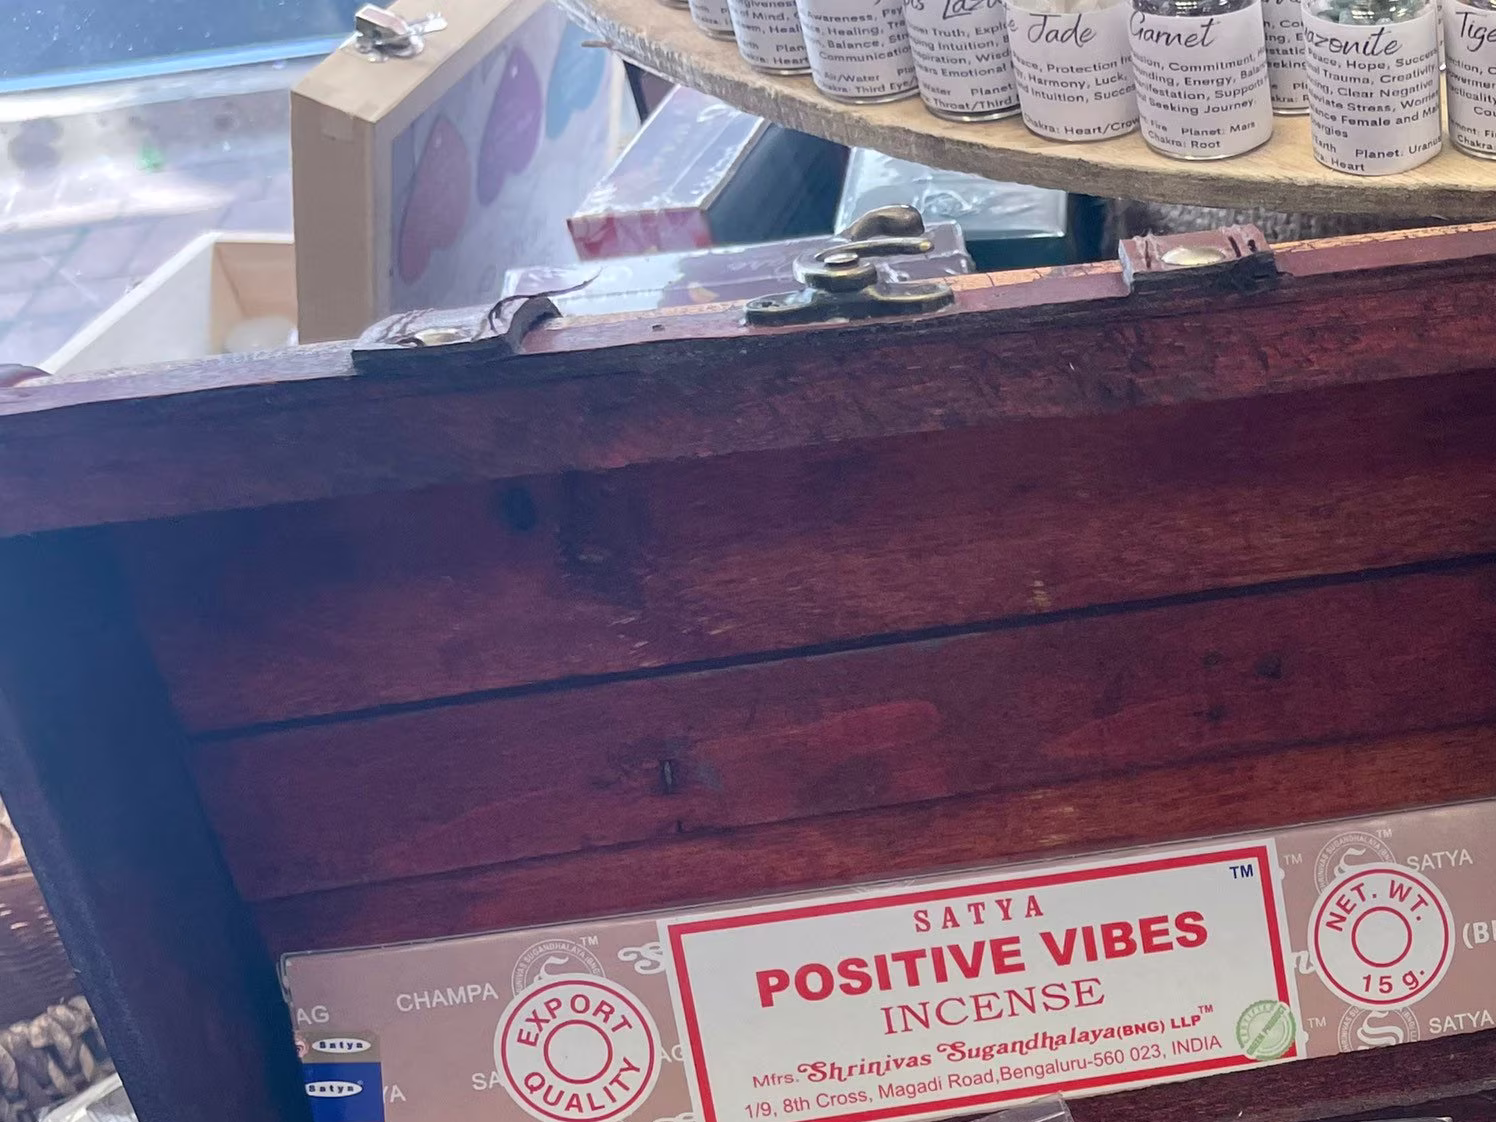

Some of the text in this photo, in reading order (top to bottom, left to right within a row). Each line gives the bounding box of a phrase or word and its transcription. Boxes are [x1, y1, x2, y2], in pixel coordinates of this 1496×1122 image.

[1027, 13, 1097, 47] Jade
[1130, 11, 1219, 48] Garnet
[1305, 27, 1401, 56] azonite
[1046, 61, 1118, 75] Protection
[1168, 54, 1258, 72] Commitment,
[1184, 72, 1237, 87] Energy,
[1028, 74, 1090, 90] Harmony,
[1407, 848, 1473, 870] SATYA
[914, 895, 1044, 933] SATYA
[755, 911, 1208, 1008] POSITIVE VIBES
[396, 982, 499, 1012] CHAMPA
[880, 978, 1105, 1035] INCENSE
[516, 993, 634, 1048] EXPORT
[1429, 1010, 1495, 1034] SATYA
[523, 1056, 642, 1114] QUALITY
[744, 1101, 777, 1118] 1/9,
[783, 1096, 810, 1113] 8th
[816, 1090, 872, 1108] Cross,
[878, 1076, 942, 1099] Magadi
[1130, 1044, 1166, 1061] 023,
[1172, 1035, 1222, 1055] INDIA
[752, 1071, 799, 1088] Mfrs.
[797, 1054, 932, 1083] Shrinivas
